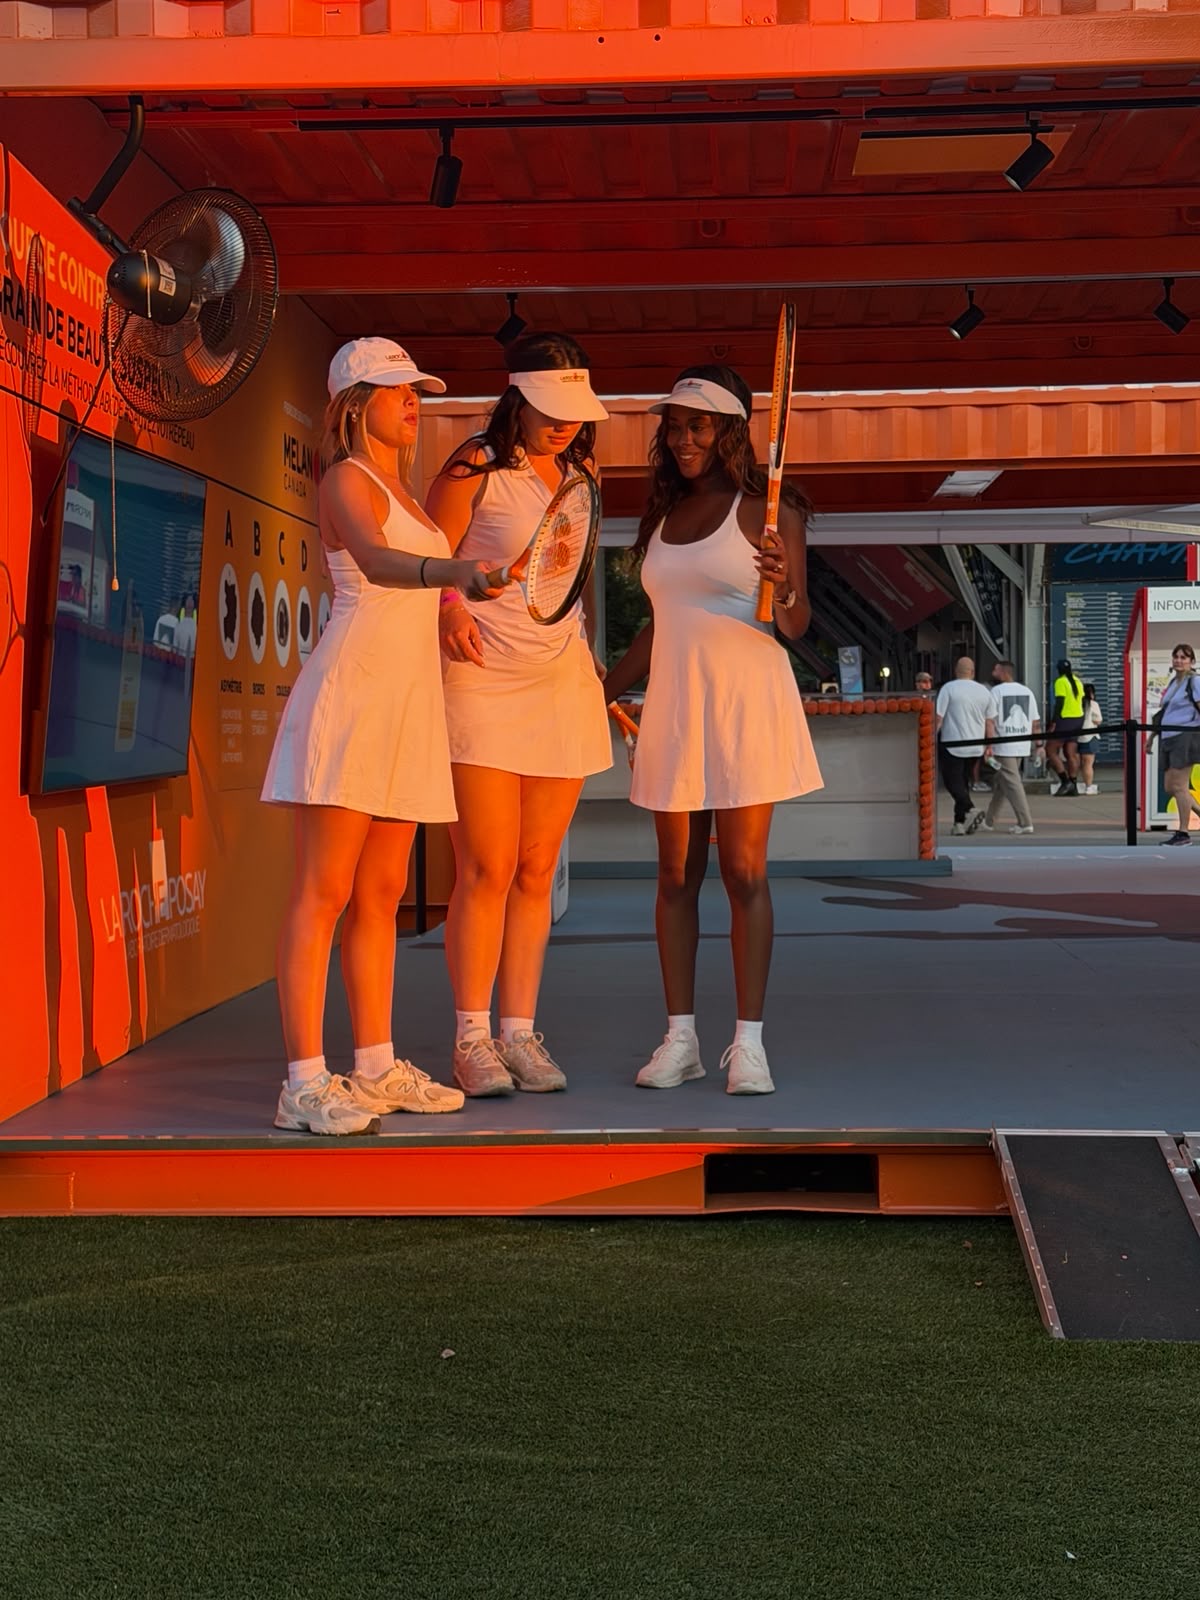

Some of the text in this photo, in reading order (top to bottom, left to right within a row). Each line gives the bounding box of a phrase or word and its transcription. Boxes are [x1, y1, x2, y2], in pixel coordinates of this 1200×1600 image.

[0, 274, 42, 335] RAIN
[46, 301, 65, 348] DE
[48, 361, 60, 389] LA
[224, 509, 308, 572] A B C D
[100, 894, 125, 943] LA
